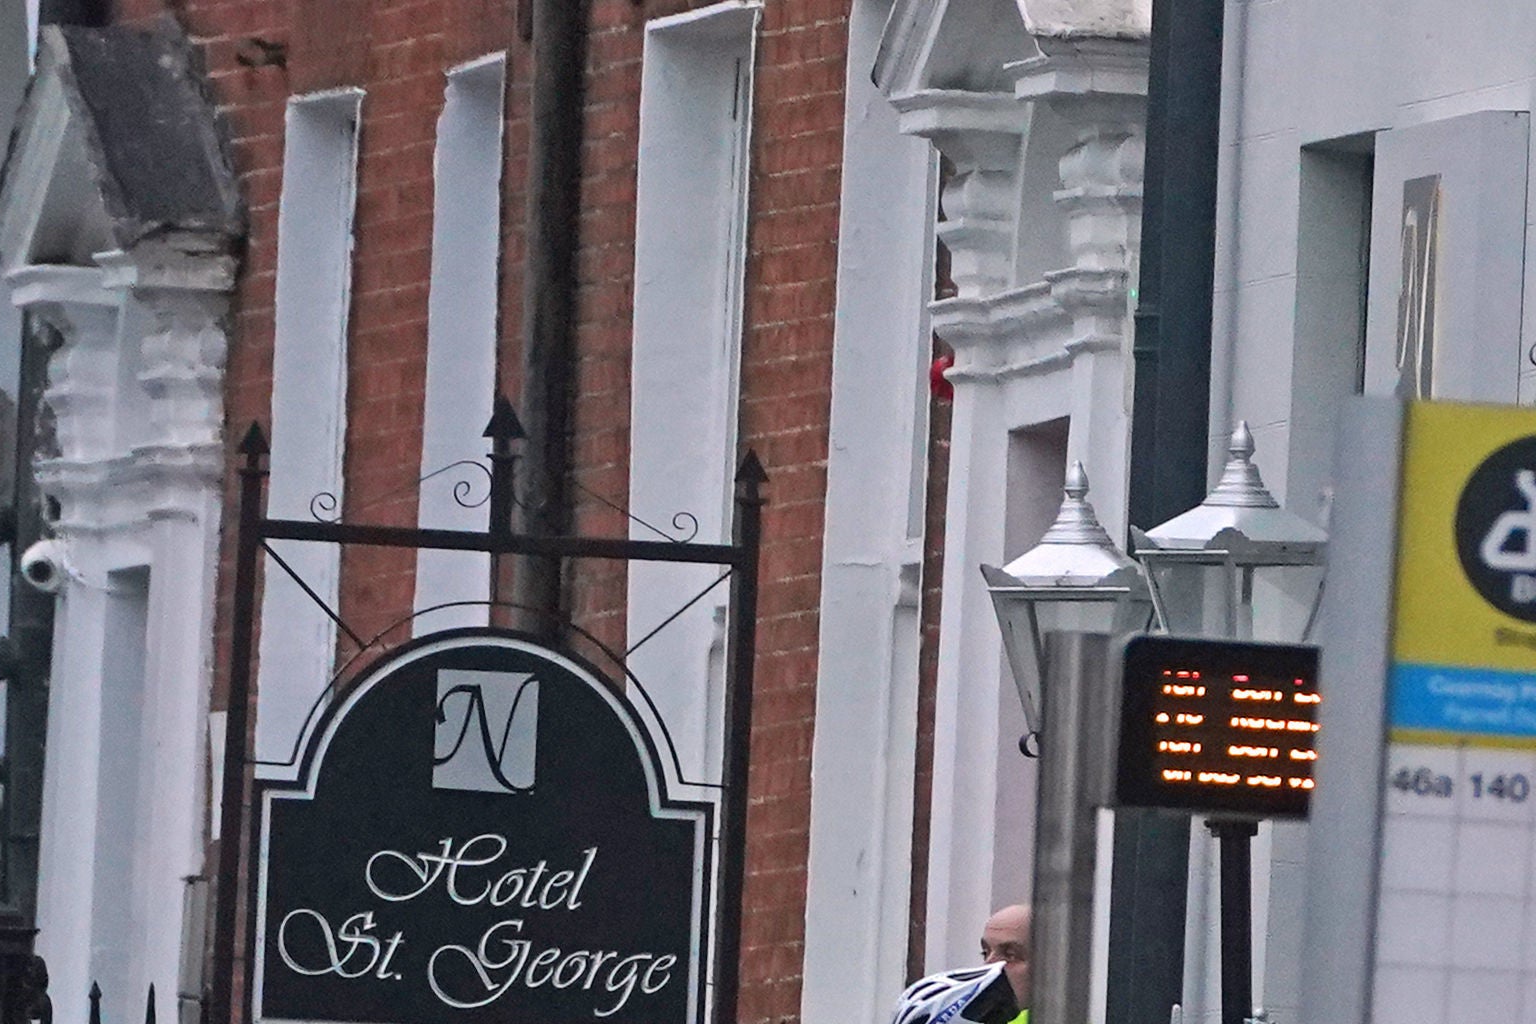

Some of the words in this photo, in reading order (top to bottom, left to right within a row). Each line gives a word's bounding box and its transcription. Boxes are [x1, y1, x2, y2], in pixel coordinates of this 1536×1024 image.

[1470, 772, 1531, 804] 140
[365, 833, 599, 911] Hotel
[277, 908, 405, 980] St.
[427, 919, 678, 1018] George
